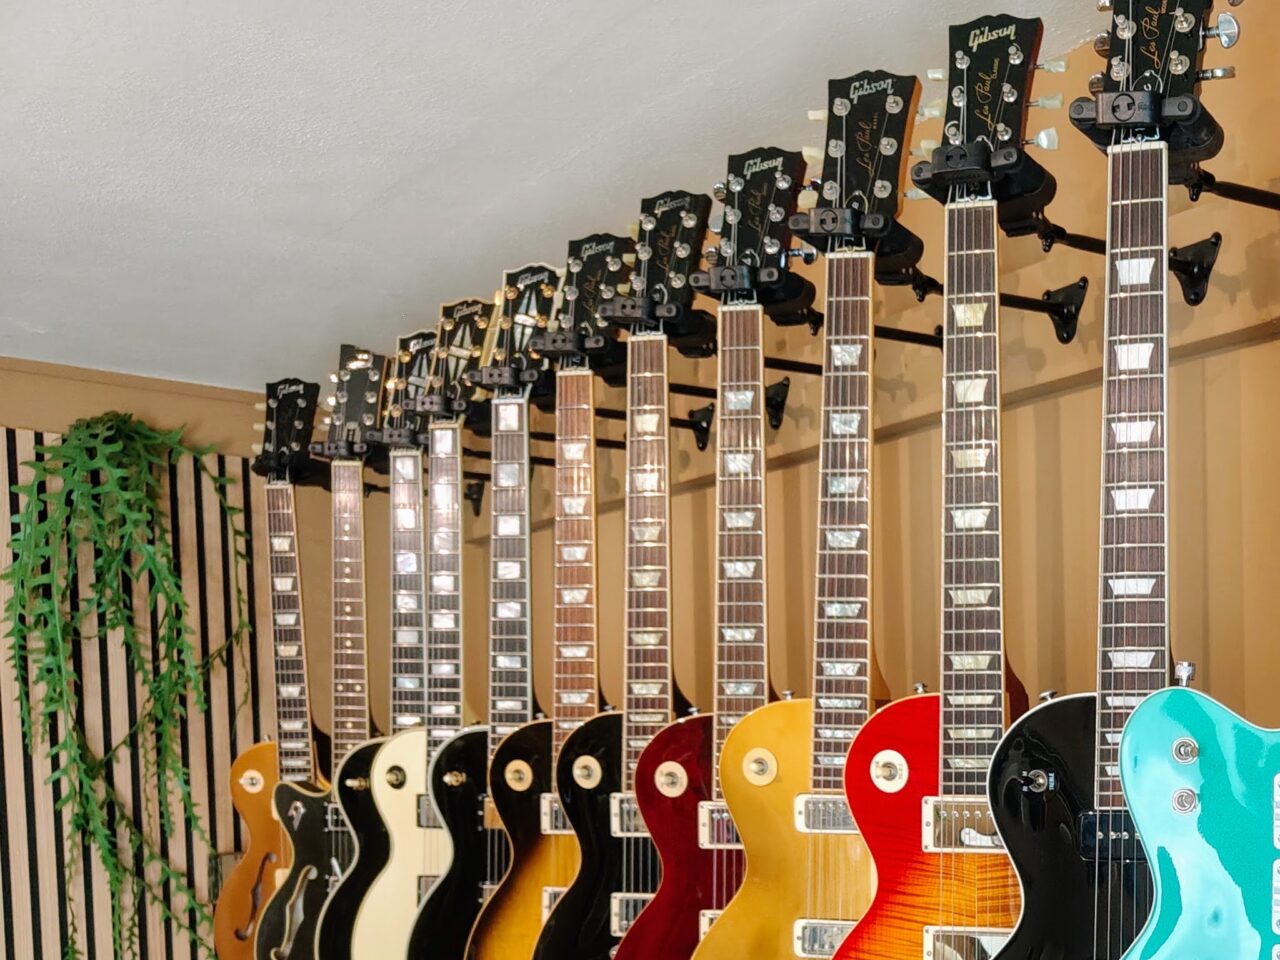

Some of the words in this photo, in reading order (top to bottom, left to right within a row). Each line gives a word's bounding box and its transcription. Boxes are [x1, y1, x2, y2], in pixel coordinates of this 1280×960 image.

[1140, 6, 1162, 40] Paul
[968, 24, 1017, 53] Gibson
[1139, 41, 1161, 70] Les
[849, 78, 894, 105] Gibson
[975, 72, 995, 104] Paul
[975, 105, 997, 132] Les
[855, 121, 873, 152] Paul
[743, 157, 784, 180] Gibson
[654, 196, 691, 219] Gibson
[581, 241, 615, 262] Gibson
[516, 271, 550, 292] Gibson
[453, 303, 483, 322] Gibson
